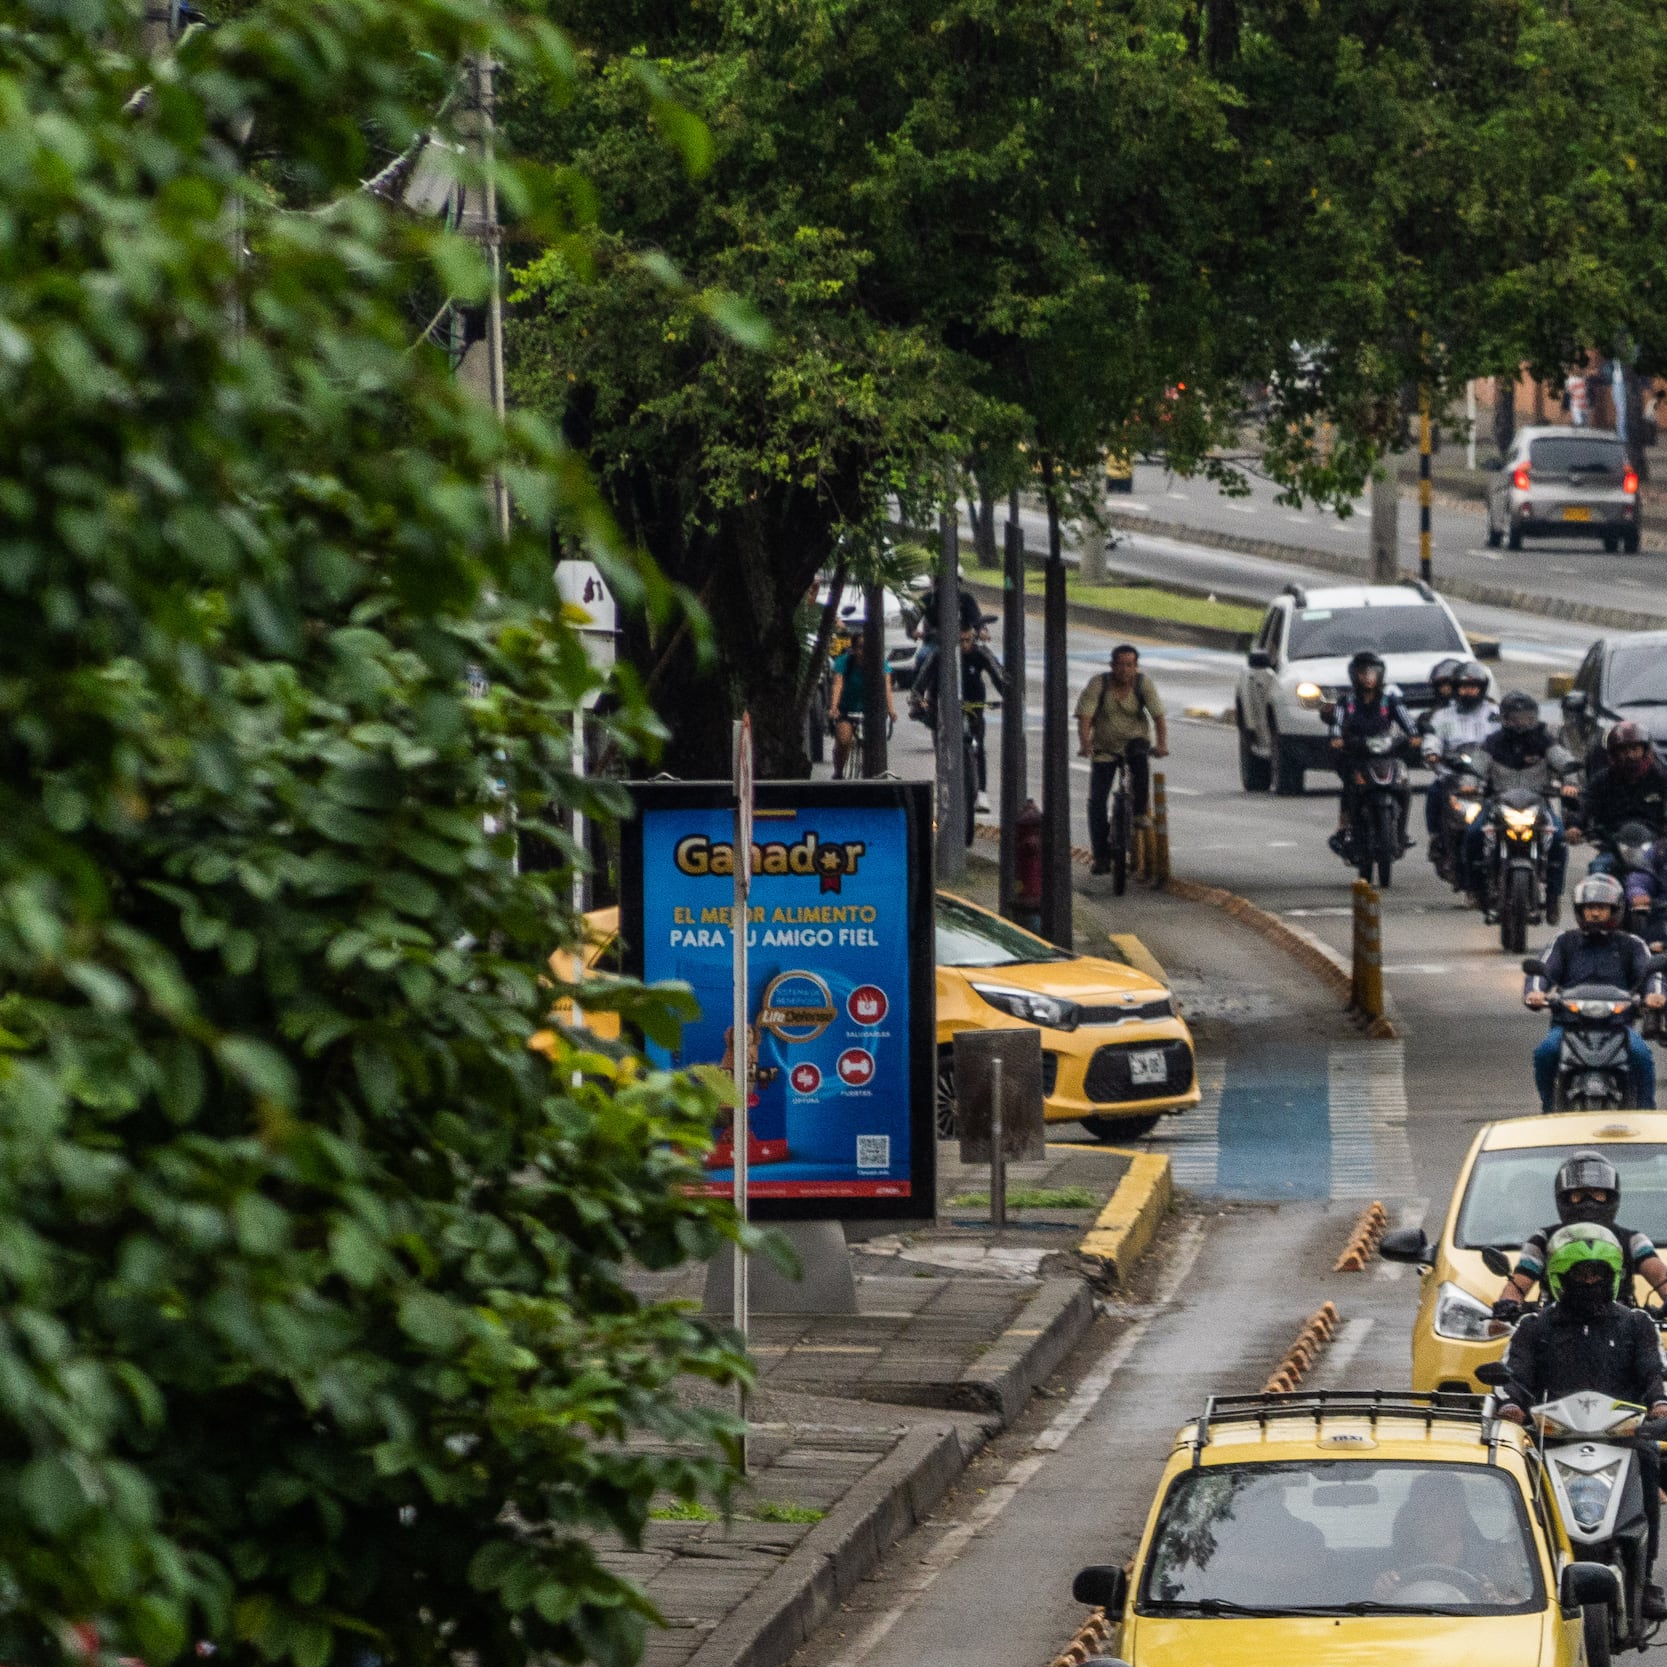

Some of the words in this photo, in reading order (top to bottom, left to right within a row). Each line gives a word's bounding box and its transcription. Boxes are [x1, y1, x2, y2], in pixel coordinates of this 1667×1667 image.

[673, 907, 696, 924] EL
[771, 906, 877, 924] ALIMENTO
[670, 929, 726, 947] PARA
[762, 929, 834, 947] AMIGO
[839, 929, 879, 946] FIEL
